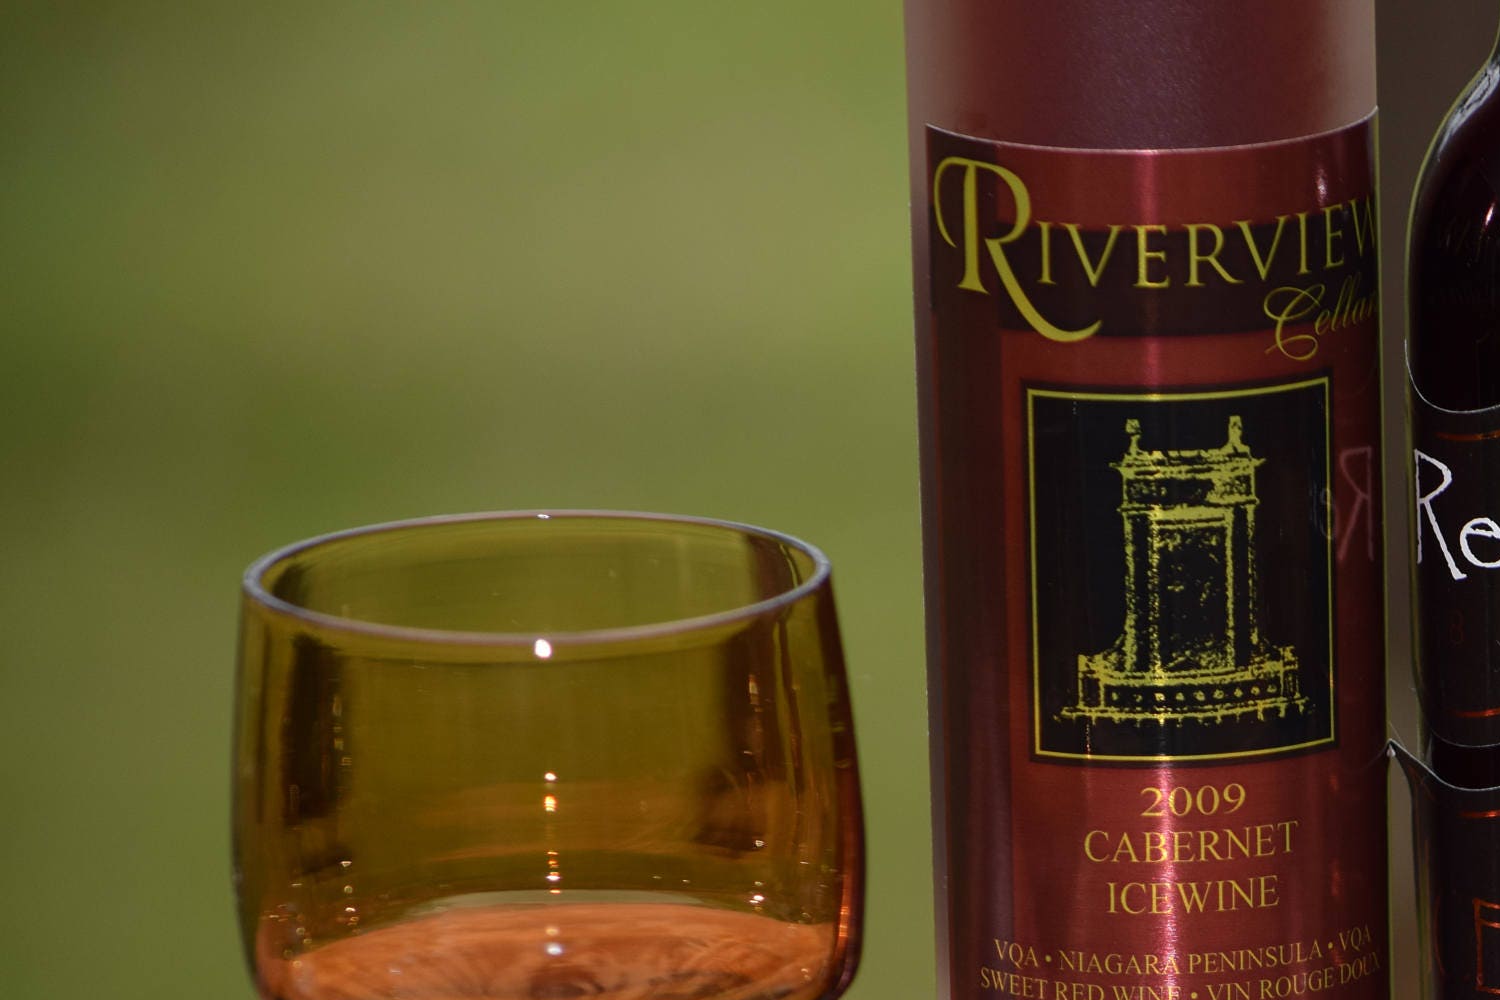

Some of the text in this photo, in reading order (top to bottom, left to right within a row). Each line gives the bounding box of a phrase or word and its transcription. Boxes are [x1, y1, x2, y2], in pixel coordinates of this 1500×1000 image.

[934, 157, 1376, 342] RIVERVIEW
[1140, 783, 1246, 817] 2009
[1084, 820, 1299, 863] CABERNET
[994, 924, 1371, 975] VQA NIAGARA PENINSULA VQA
[980, 966, 1047, 999] SWEET
[1259, 967, 1334, 1000] ROUGE
